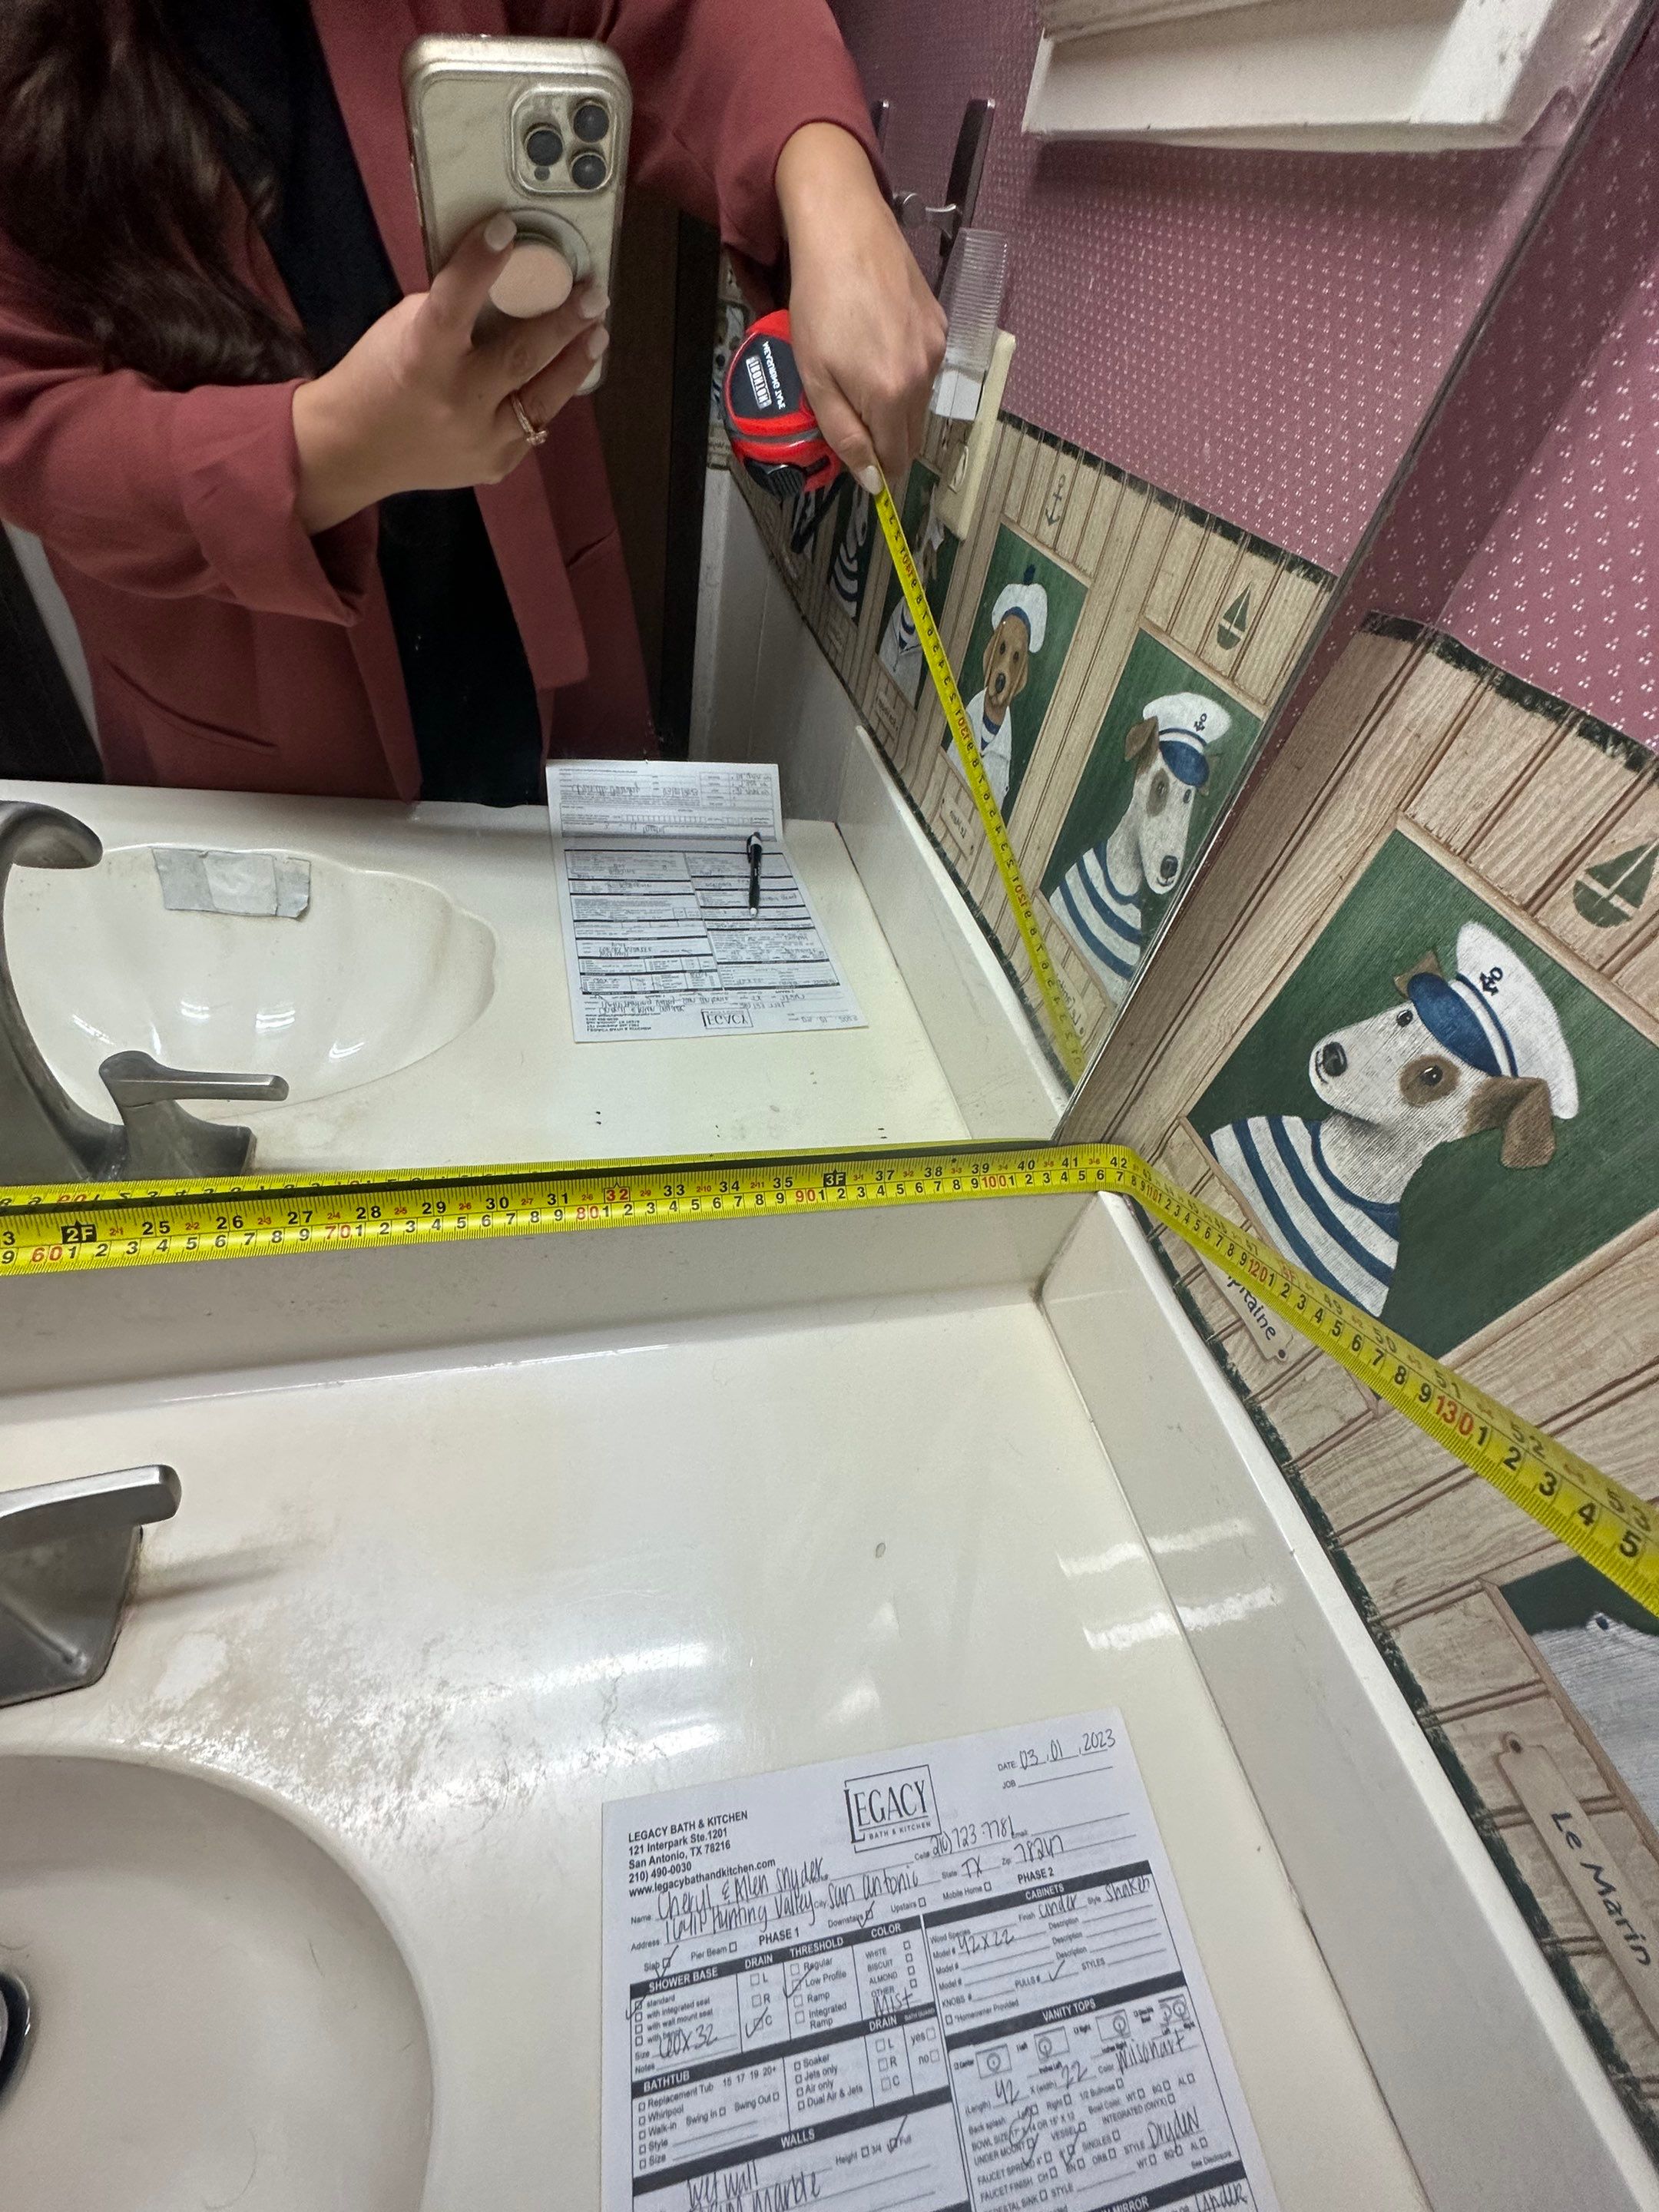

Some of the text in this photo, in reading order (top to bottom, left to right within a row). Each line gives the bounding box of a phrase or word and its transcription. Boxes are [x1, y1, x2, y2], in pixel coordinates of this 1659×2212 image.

[141, 1220, 171, 1236] 25
[216, 1214, 244, 1230] 26
[288, 1210, 313, 1226] 27
[356, 1205, 382, 1220] 28
[422, 1200, 447, 1215] 29
[485, 1195, 510, 1210] 30
[547, 1193, 569, 1206] 31
[606, 1187, 629, 1201] 32
[663, 1184, 686, 1197] 33
[719, 1181, 740, 1193] 34
[773, 1177, 793, 1189] 35
[876, 1170, 895, 1181] 37
[924, 1166, 943, 1178] 38
[971, 1162, 990, 1174] 39
[1018, 1160, 1036, 1171] 40
[1061, 1157, 1079, 1168] 41
[1110, 1156, 1128, 1169] 42
[2, 1174, 1642, 1558] 9 60 2 3 4 5 6 7 8 9 70 80 90 100 120 2 3 4 5 6 8 9 130 2 3 4 5
[1081, 1728, 1116, 1752] 2023
[1002, 1779, 1017, 1790] JOB
[843, 1780, 928, 1845] LEGACY
[628, 1810, 748, 1843] LEGACY BATH & KITCHEN
[869, 1830, 889, 1840] BATH
[899, 1820, 932, 1835] KITCHEN
[628, 1857, 647, 1870] San
[690, 1846, 703, 1857] TX
[704, 1839, 731, 1854] 78216
[629, 1844, 644, 1856] 121
[647, 1835, 689, 1853] Interpark
[628, 1858, 777, 1899] www.legacybathandkitchen.com
[650, 1860, 692, 1878] 490-0030
[1017, 1866, 1055, 1885] PHASE 2
[963, 1883, 983, 1896] Home
[1025, 1883, 1065, 1901] CABINETS
[1551, 1810, 1652, 1968] Le Marin
[759, 1926, 800, 1946] PHASE 1
[870, 1922, 902, 1939] COLOR
[706, 1945, 728, 1958] Beam
[790, 1936, 845, 1959] THRESHOLD
[865, 1949, 888, 1959] WHITE
[744, 1953, 774, 1969] DRAIN
[803, 1958, 833, 1972] Regular
[867, 1959, 893, 1972] BISCUIT
[648, 1967, 719, 1993] SHOWER BASE
[805, 1969, 848, 1988] Low Profile
[869, 1971, 899, 1985] ALMOND
[806, 1992, 831, 2005] Ramp
[809, 2002, 848, 2030] Integrated Ramp
[1041, 1998, 1097, 2022] VANITY TOPS
[869, 2015, 898, 2032] DRAIN
[910, 2032, 926, 2047] yes
[918, 2053, 930, 2065] no
[643, 2070, 690, 2093] BATHTUB
[647, 2084, 714, 2108] Replacement Tub
[647, 2104, 684, 2123] Whirlpool
[647, 2121, 677, 2137] Walk-in
[780, 2128, 816, 2149] WALLS
